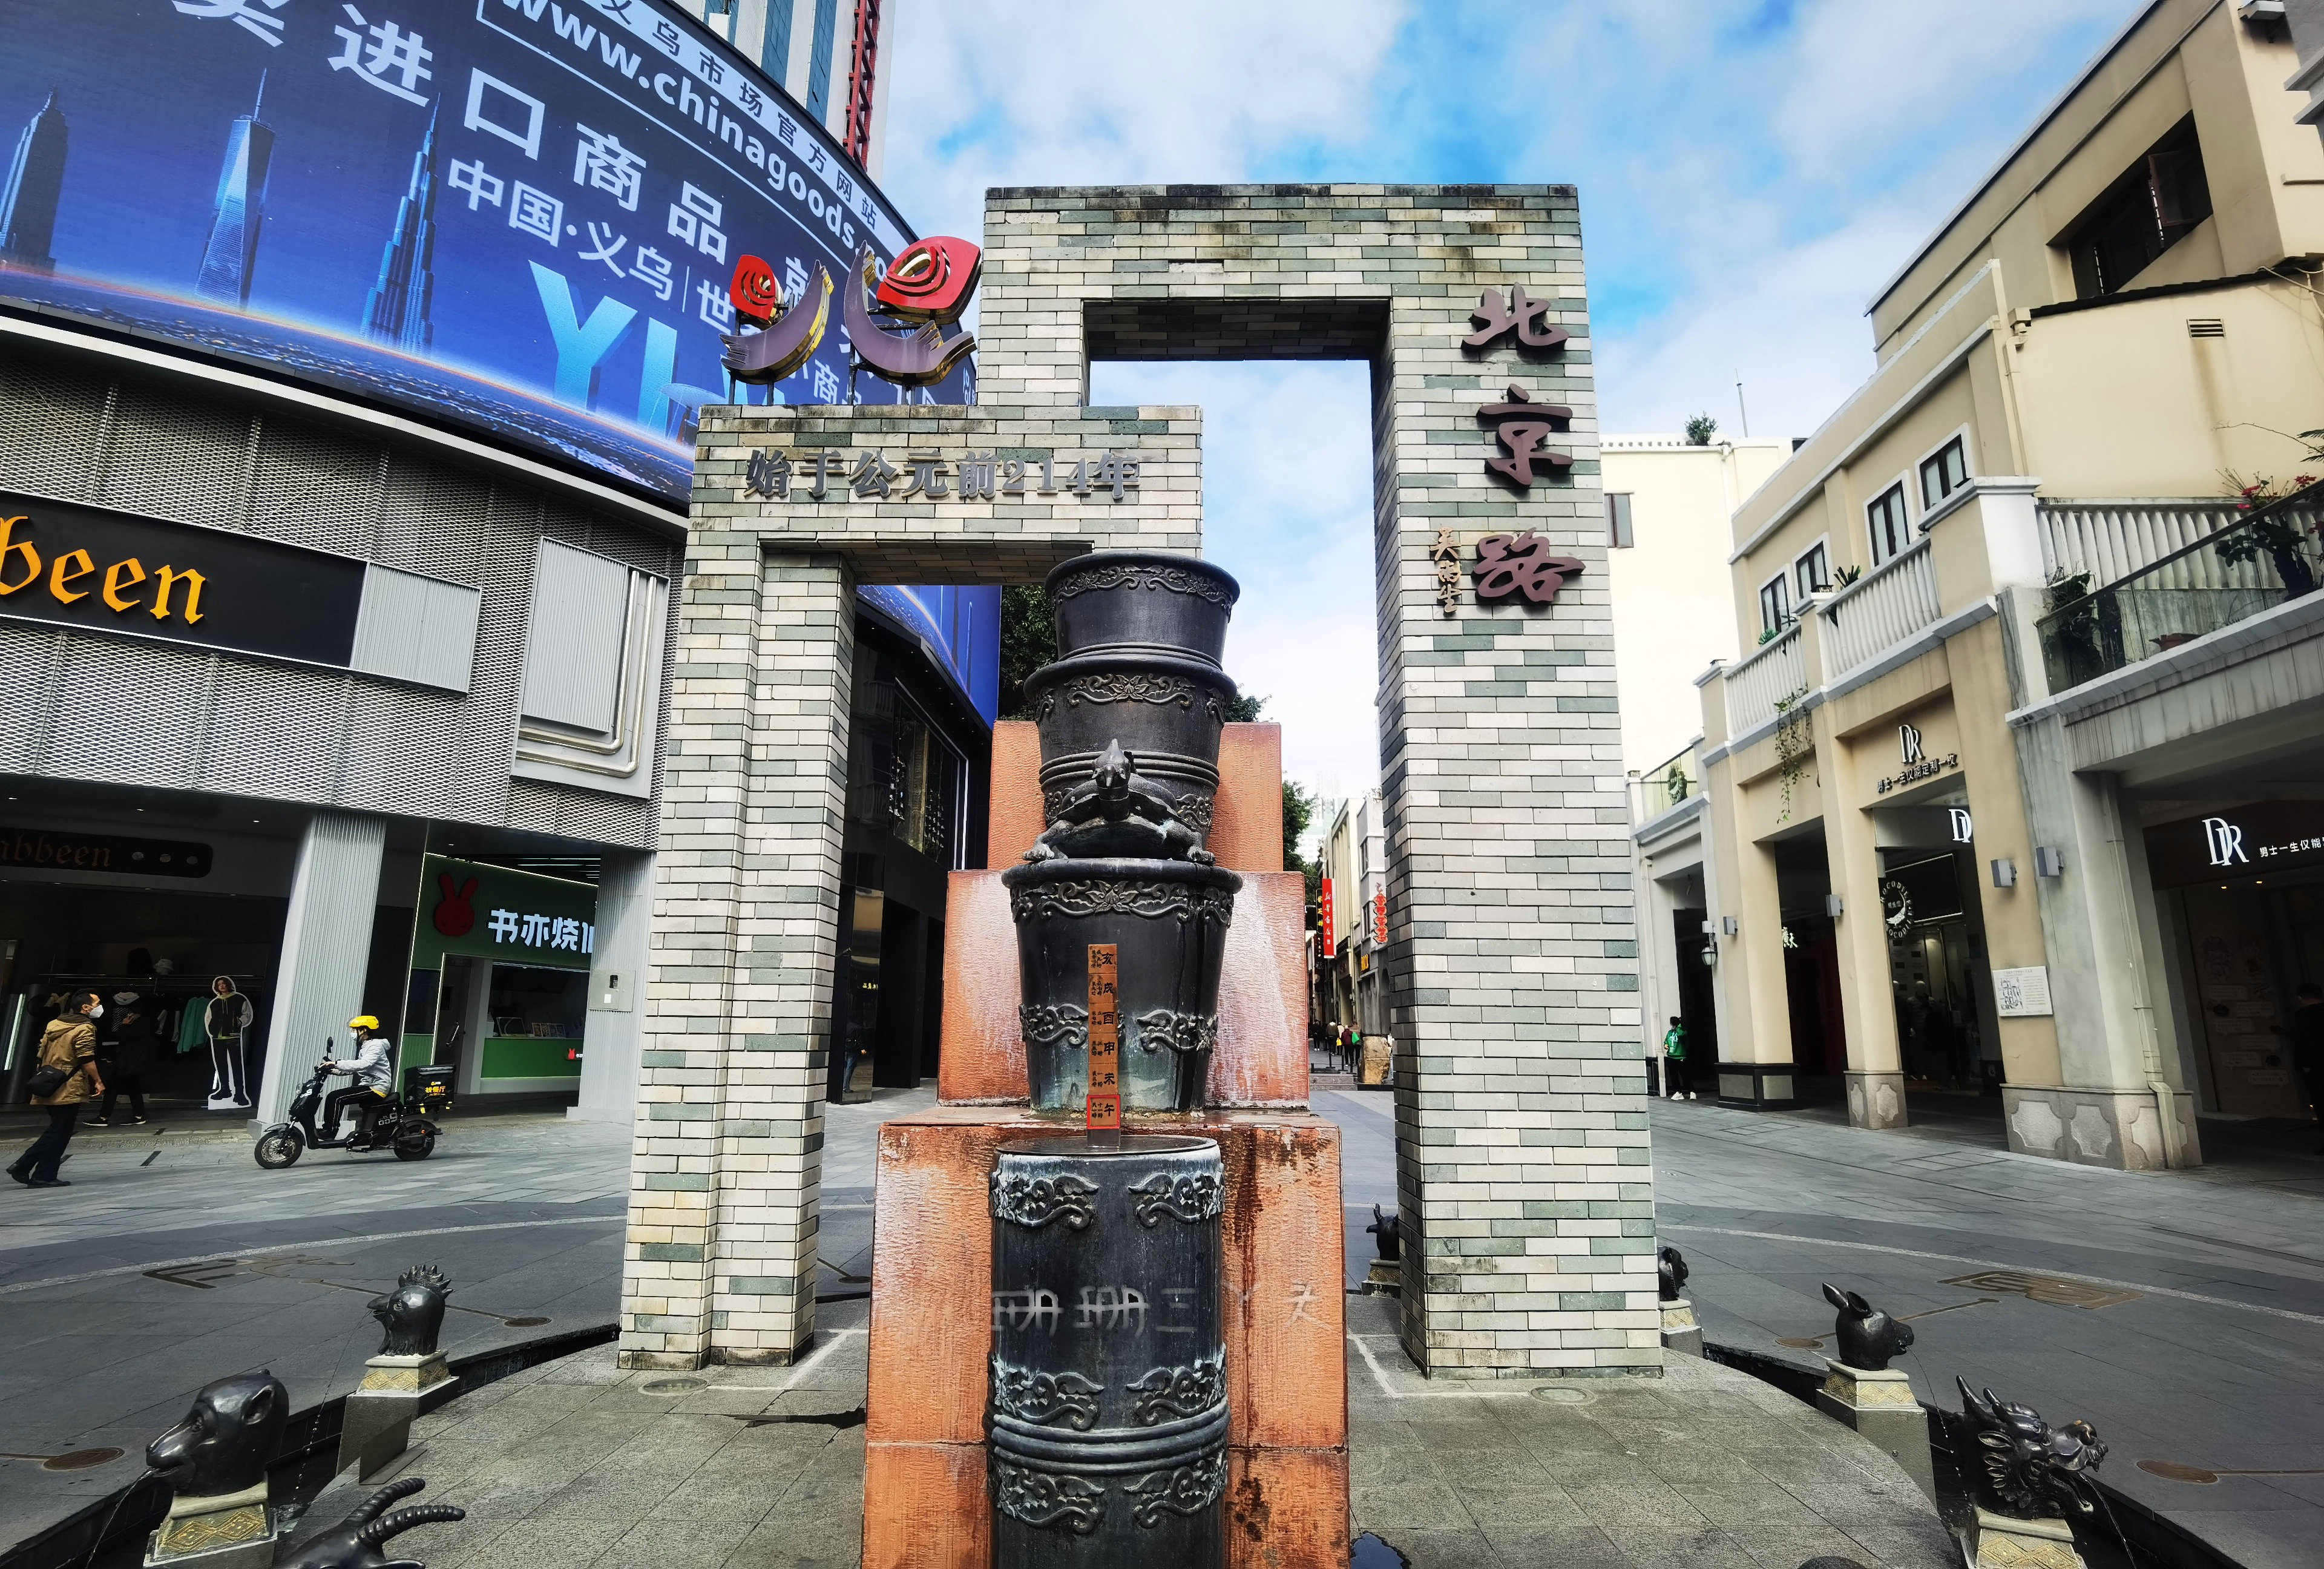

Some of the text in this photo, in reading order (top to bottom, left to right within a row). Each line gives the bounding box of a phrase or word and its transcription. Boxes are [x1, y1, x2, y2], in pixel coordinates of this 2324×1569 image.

[601, 0, 875, 230] 义乌市场官方网站
[1460, 281, 1586, 602] 北京路
[744, 449, 1139, 500] 始于公元前214年
[1899, 724, 1925, 764] DR
[2202, 817, 2250, 866] DR
[2259, 837, 2324, 858] 男士一生仅能
